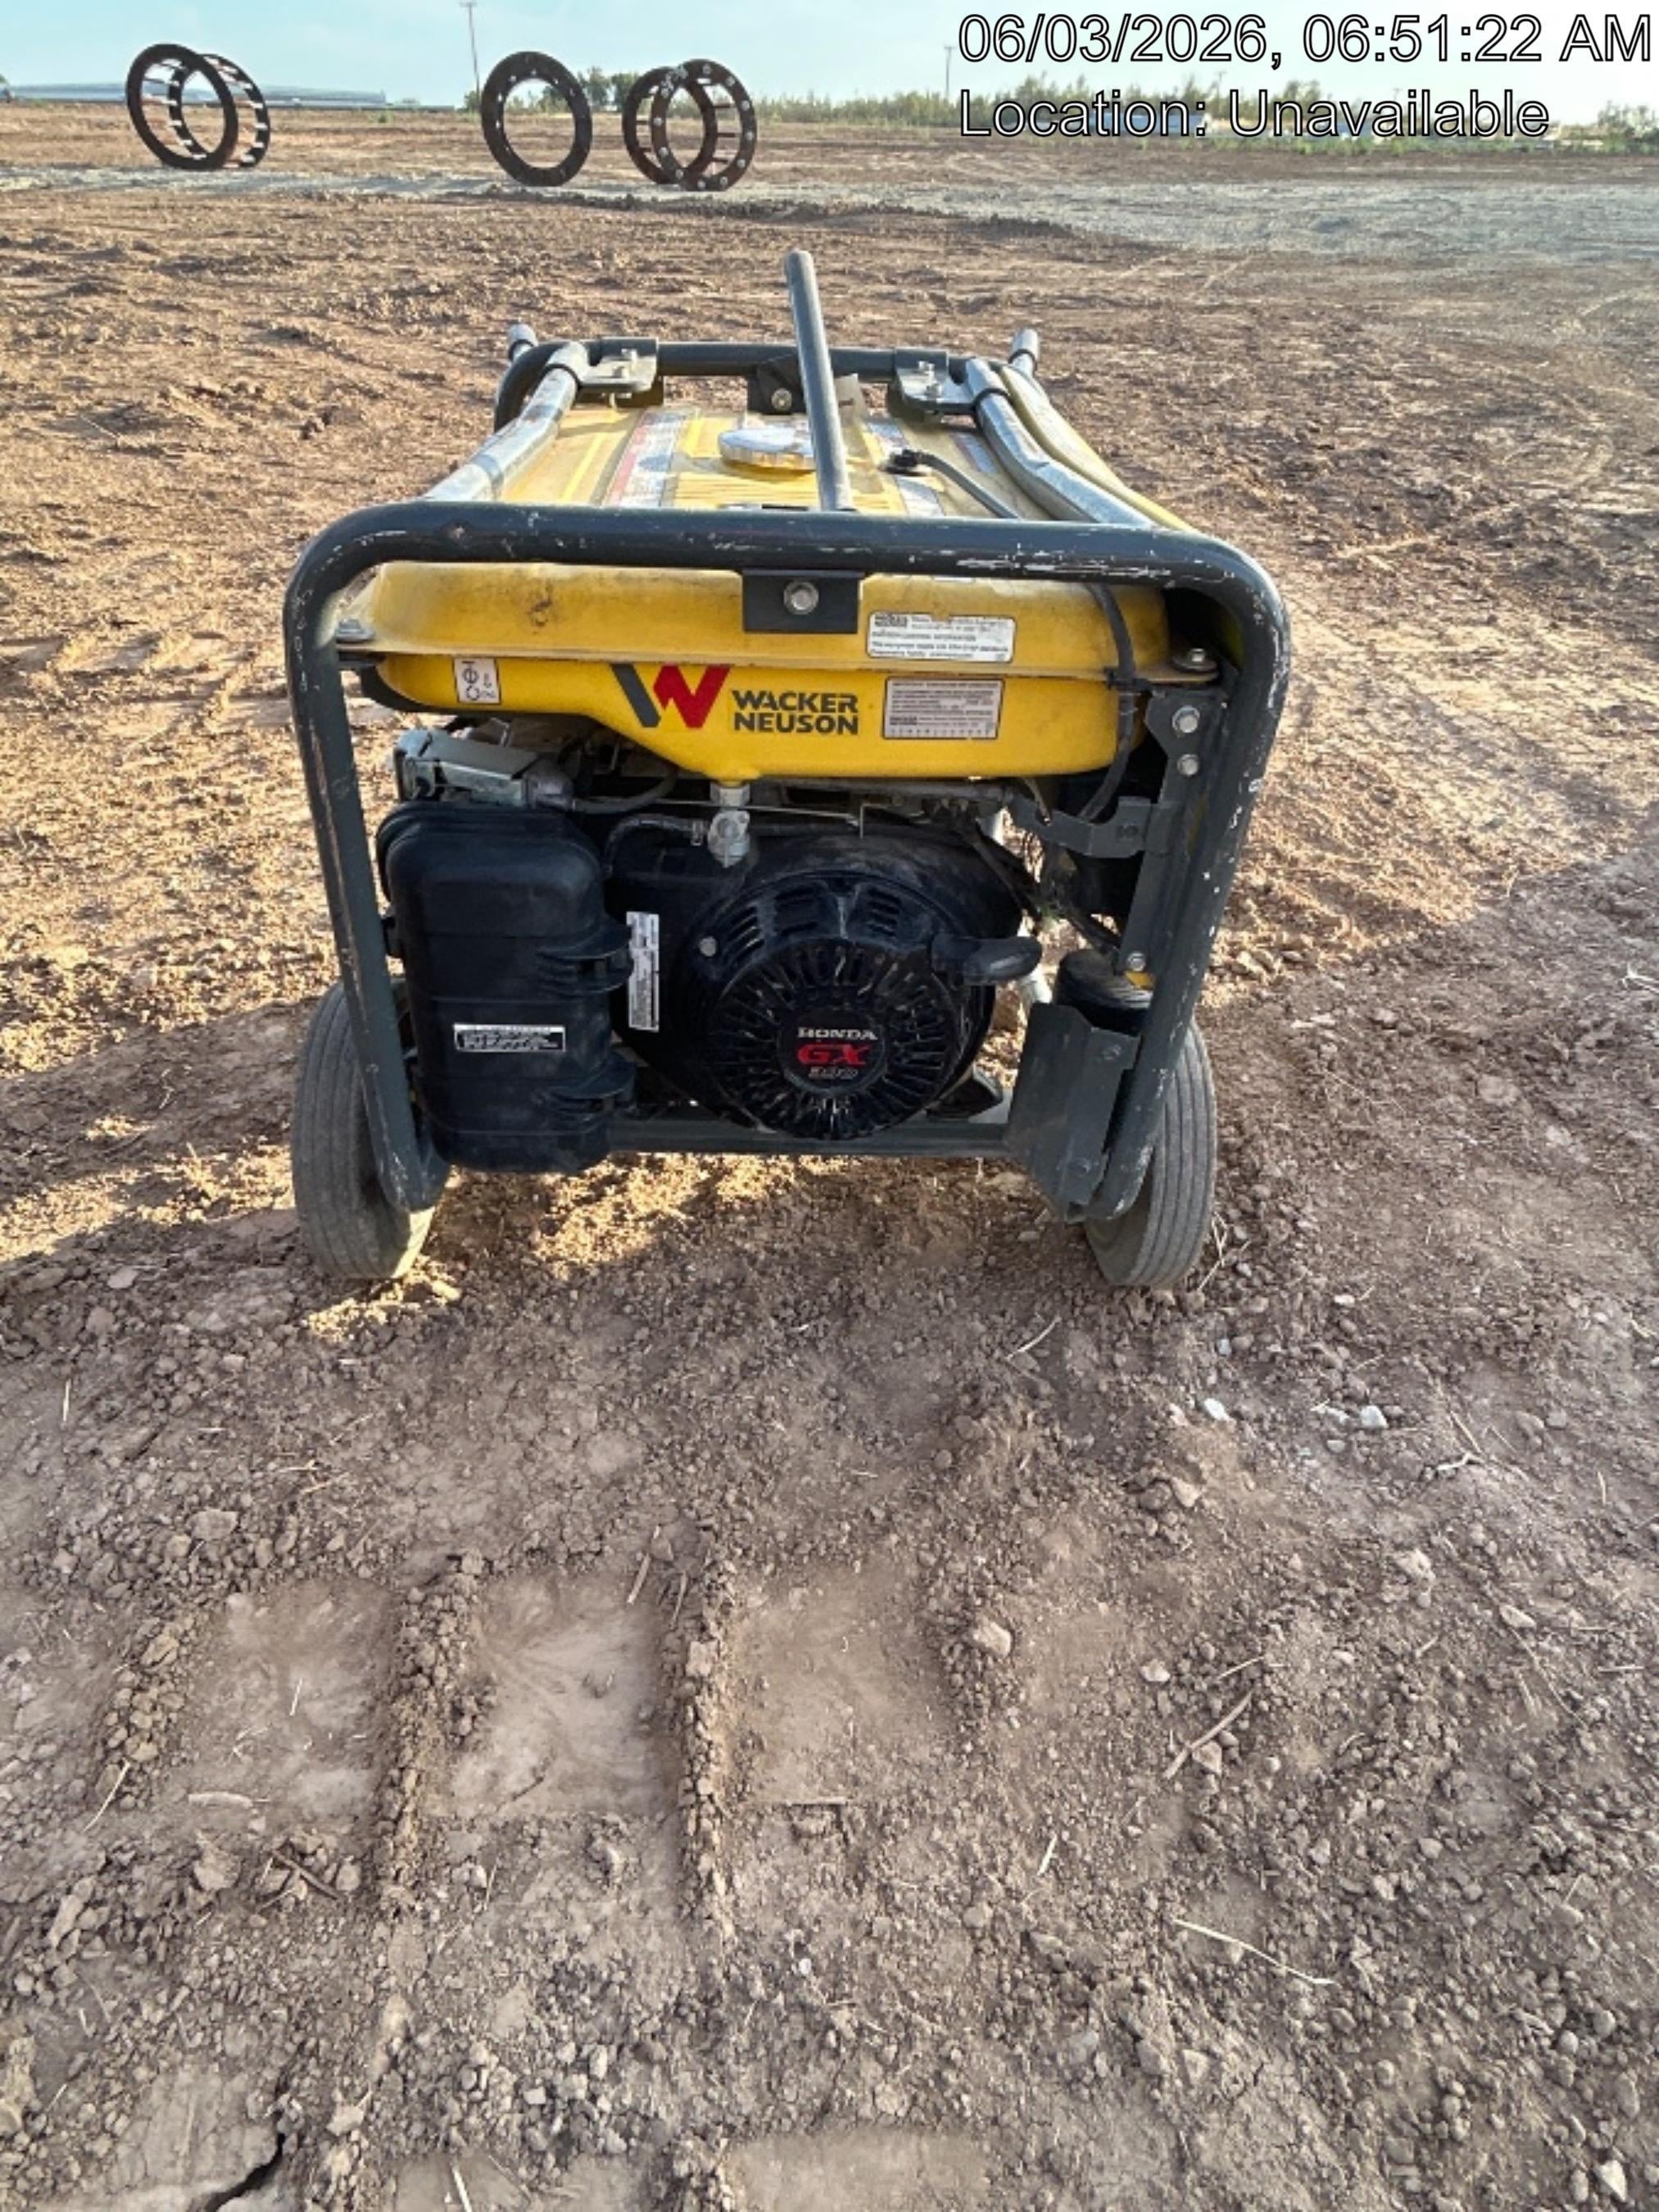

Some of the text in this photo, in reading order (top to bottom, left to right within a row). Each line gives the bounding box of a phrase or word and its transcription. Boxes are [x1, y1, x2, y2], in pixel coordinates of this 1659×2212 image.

[732, 691, 859, 713] WACKER
[734, 713, 859, 735] NEUSON
[797, 1027, 878, 1040] HONDA
[796, 1042, 870, 1067] GX
